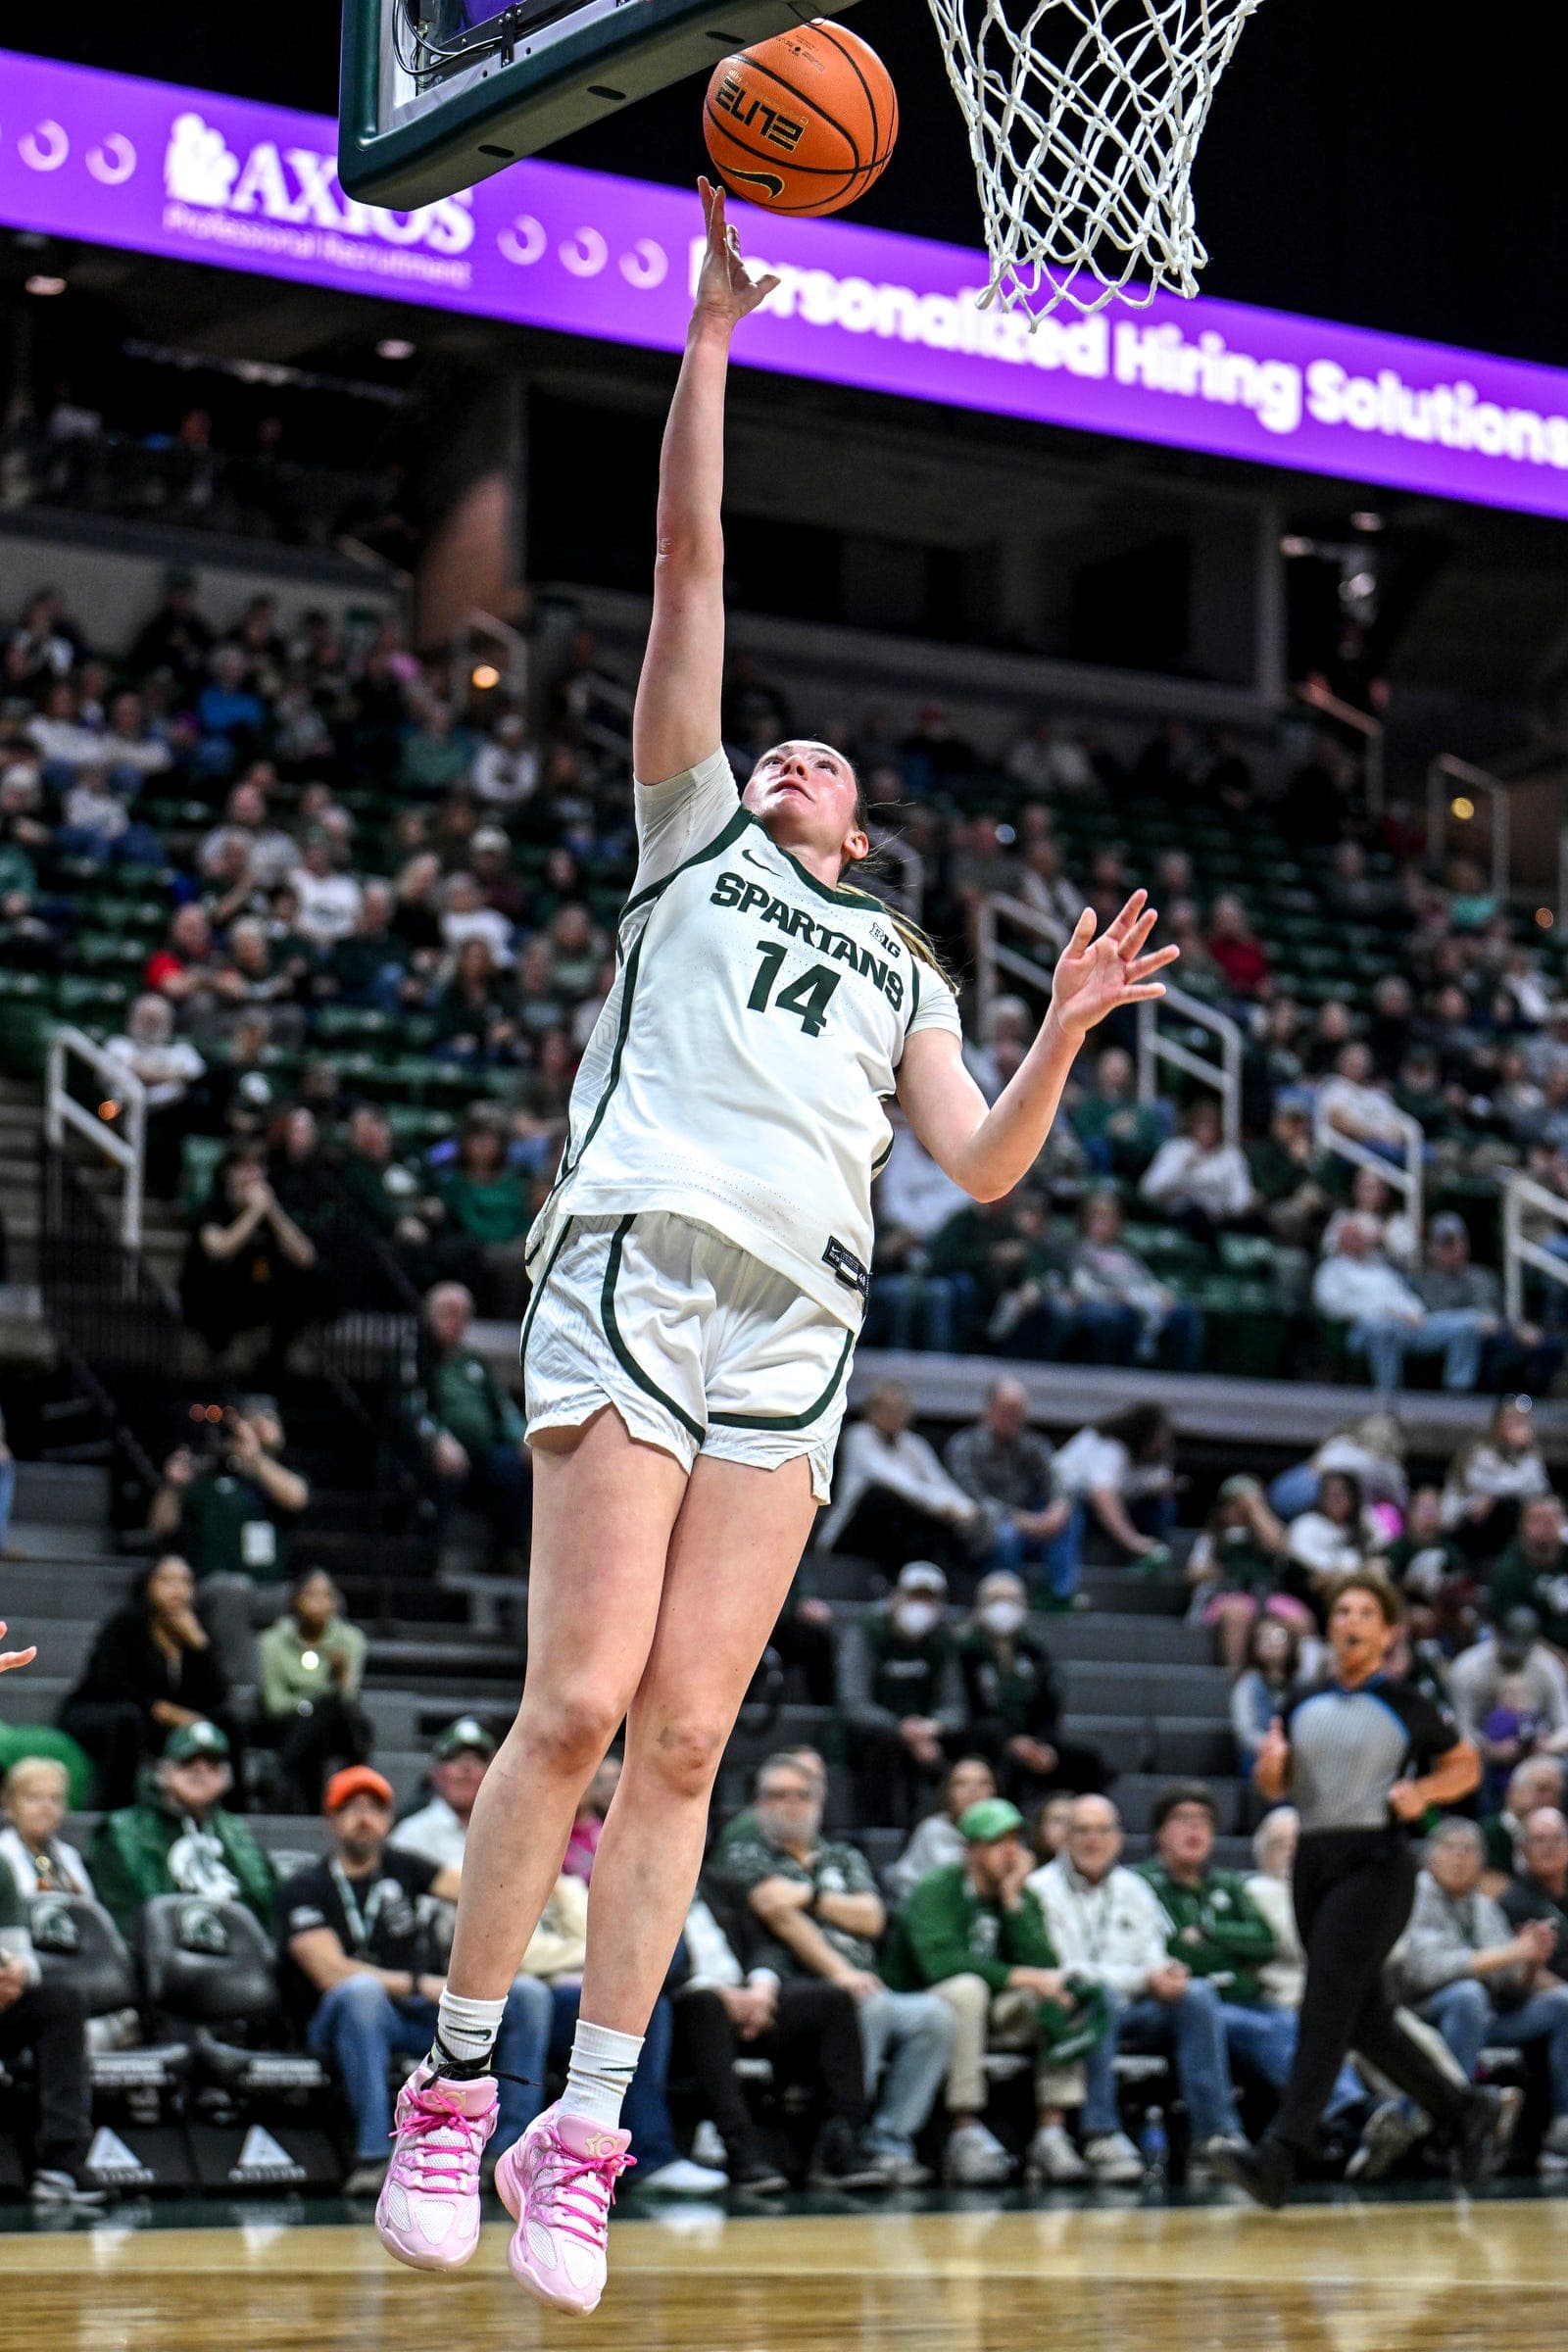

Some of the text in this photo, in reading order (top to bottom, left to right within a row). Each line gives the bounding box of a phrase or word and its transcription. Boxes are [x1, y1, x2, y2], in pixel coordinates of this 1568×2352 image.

[713, 74, 806, 153] ELITE
[1114, 320, 1302, 434] Hiring
[1305, 359, 1568, 470] Solutions
[710, 871, 905, 1012] SPARTANS
[747, 940, 842, 1039] 14
